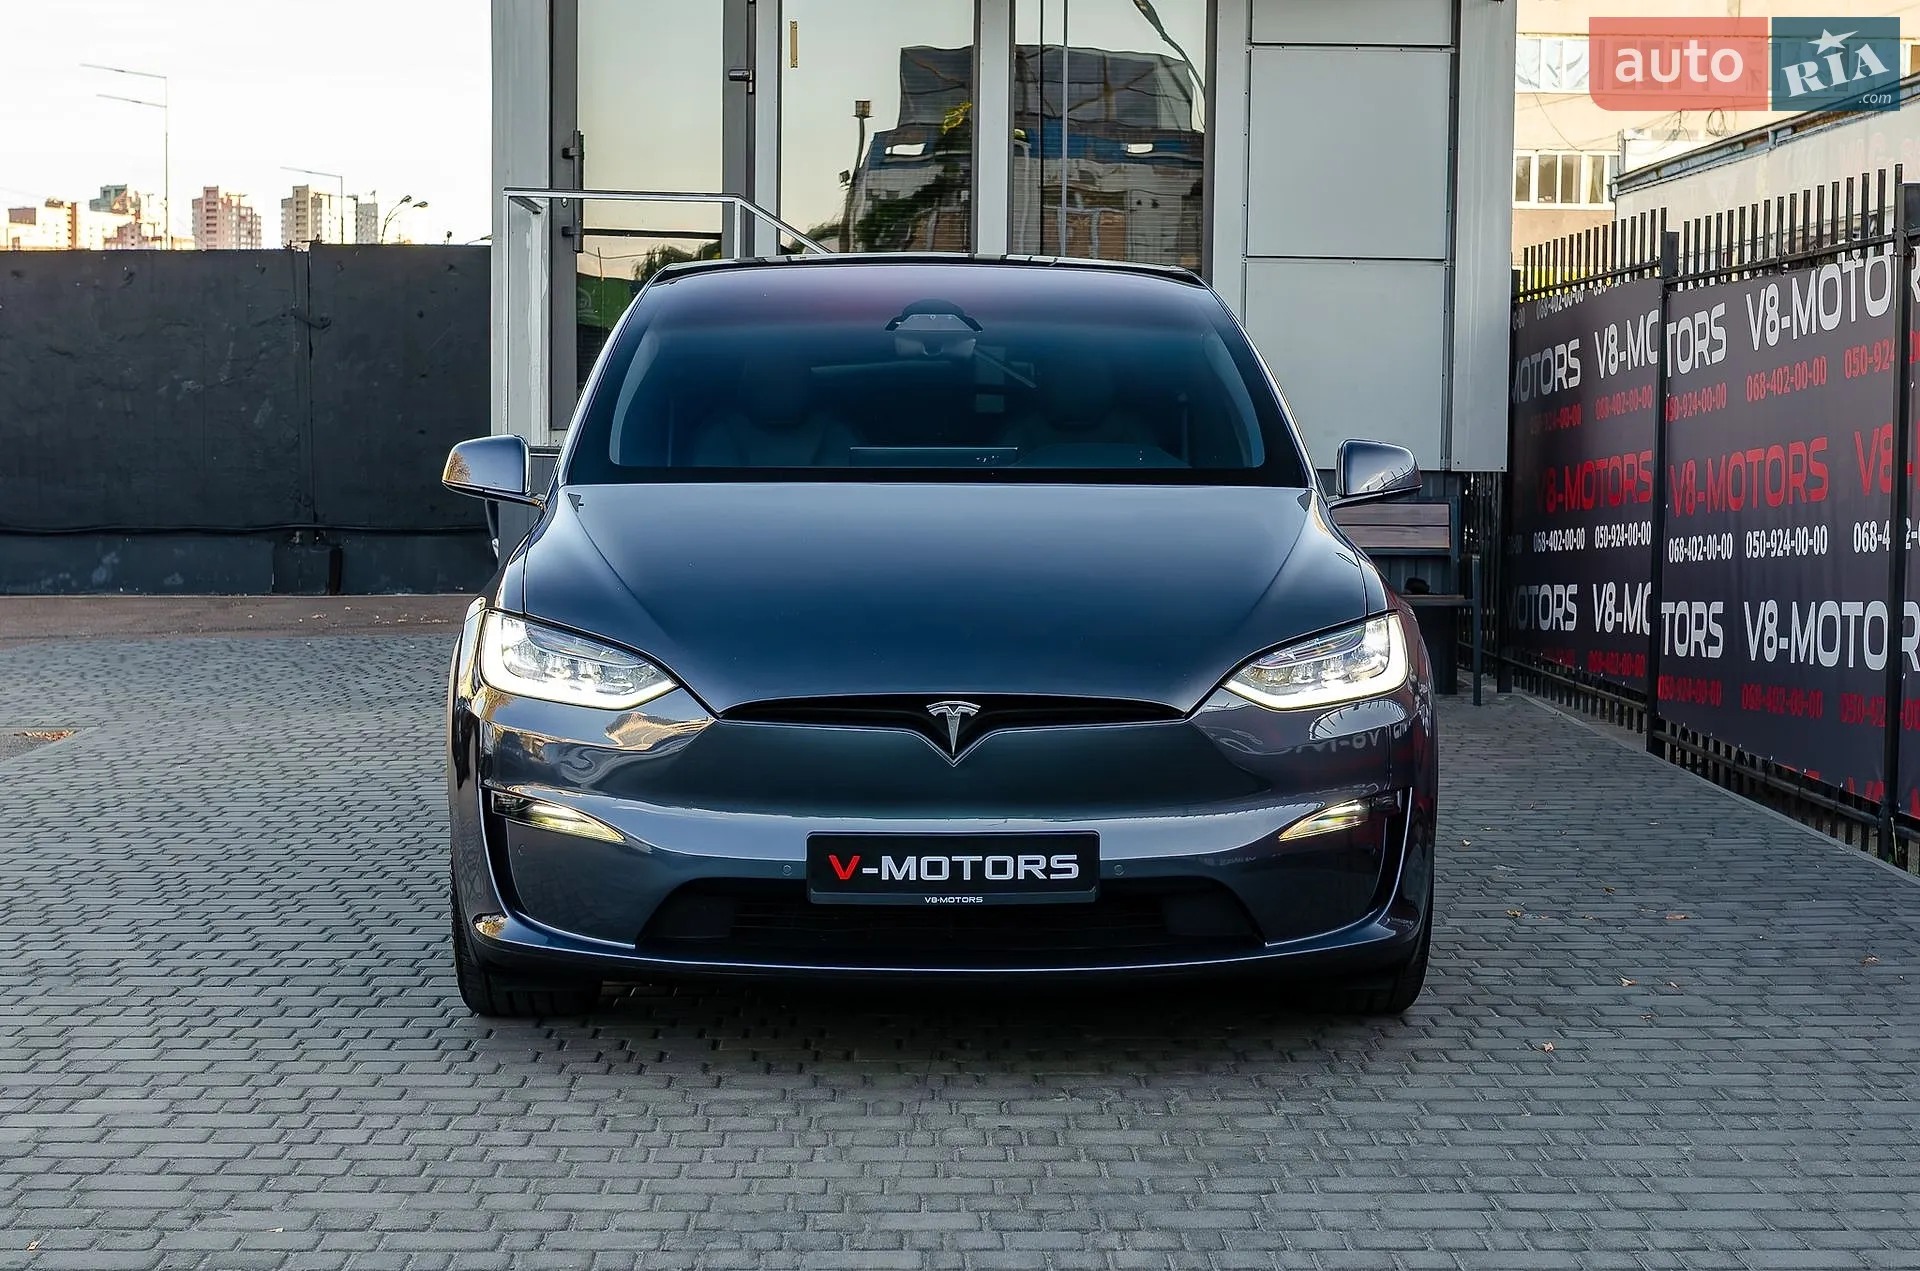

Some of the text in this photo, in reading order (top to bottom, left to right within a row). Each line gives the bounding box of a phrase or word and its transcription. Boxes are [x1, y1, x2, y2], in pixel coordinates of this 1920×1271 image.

[1746, 356, 1827, 402] 068-402-00-00
[1670, 436, 1829, 517] V8-MOTORS
[1533, 527, 1585, 553] 068-402-00-00
[1595, 521, 1652, 549] 050-924-00-00
[1668, 532, 1733, 563] 068-402-00-00
[1746, 525, 1828, 559] 050-924-00-00
[828, 854, 1080, 881] V-MOTORS
